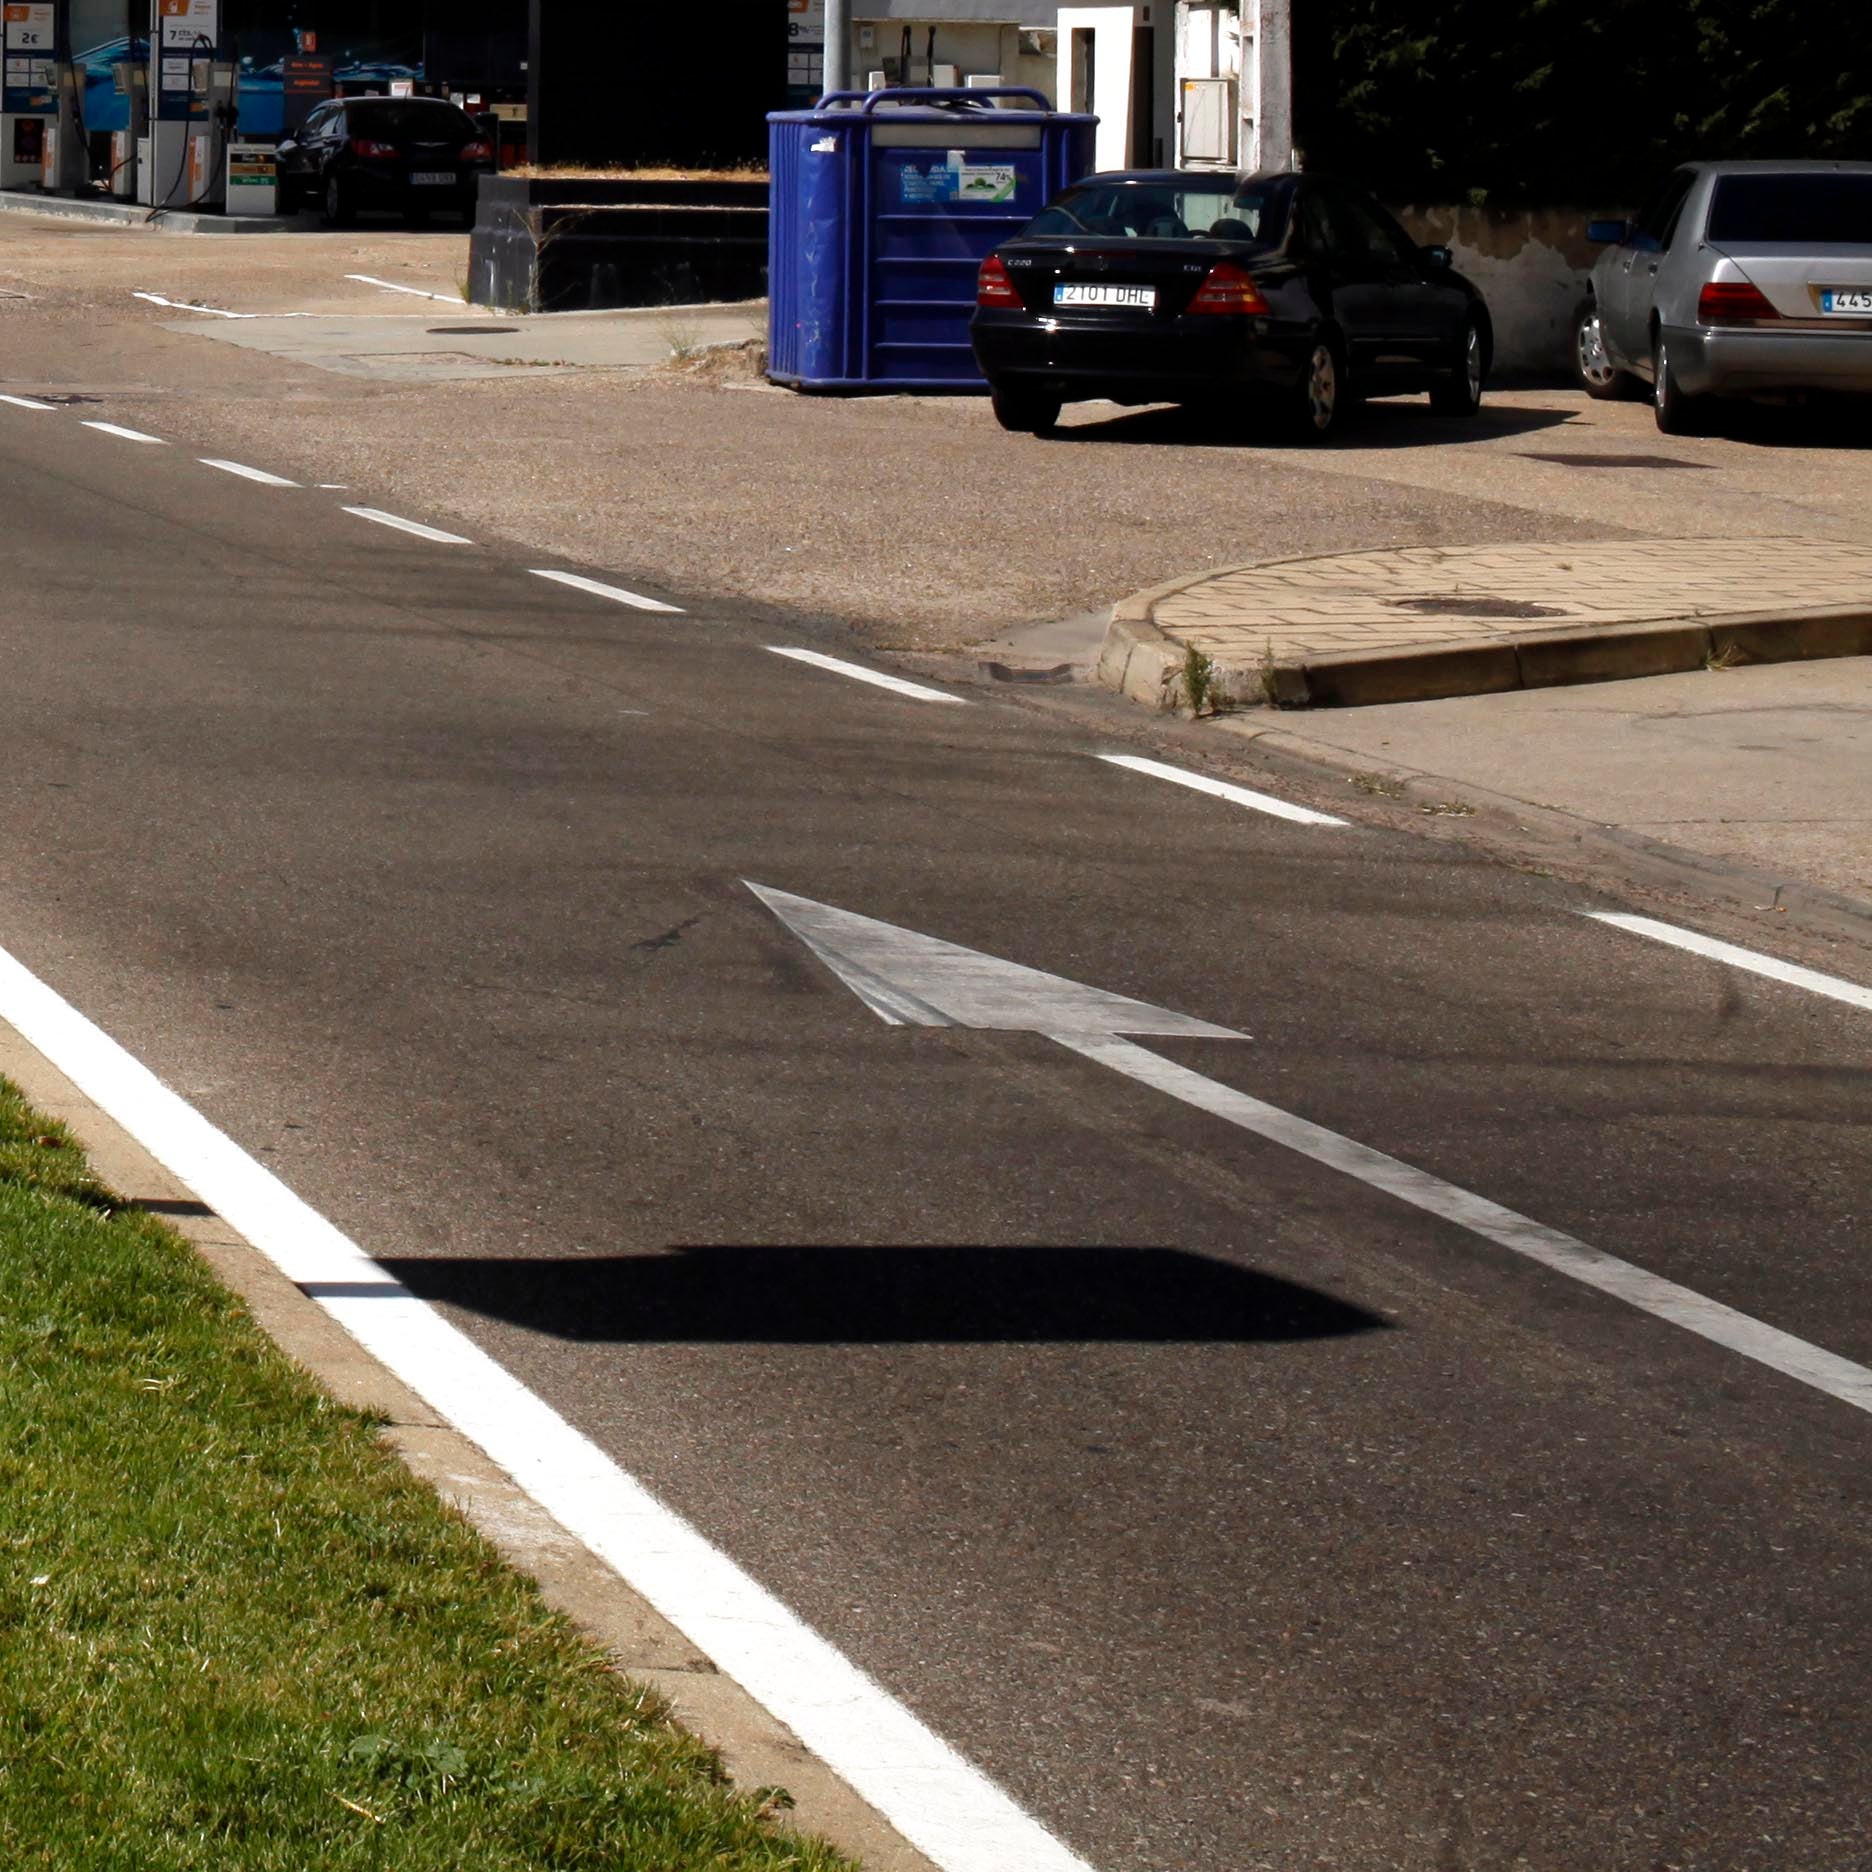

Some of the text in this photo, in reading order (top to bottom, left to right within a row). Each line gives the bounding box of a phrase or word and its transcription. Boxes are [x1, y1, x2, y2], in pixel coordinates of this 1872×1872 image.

[22, 32, 39, 44] 2€
[169, 30, 177, 41] 7
[1066, 285, 1149, 304] 2101 DHL
